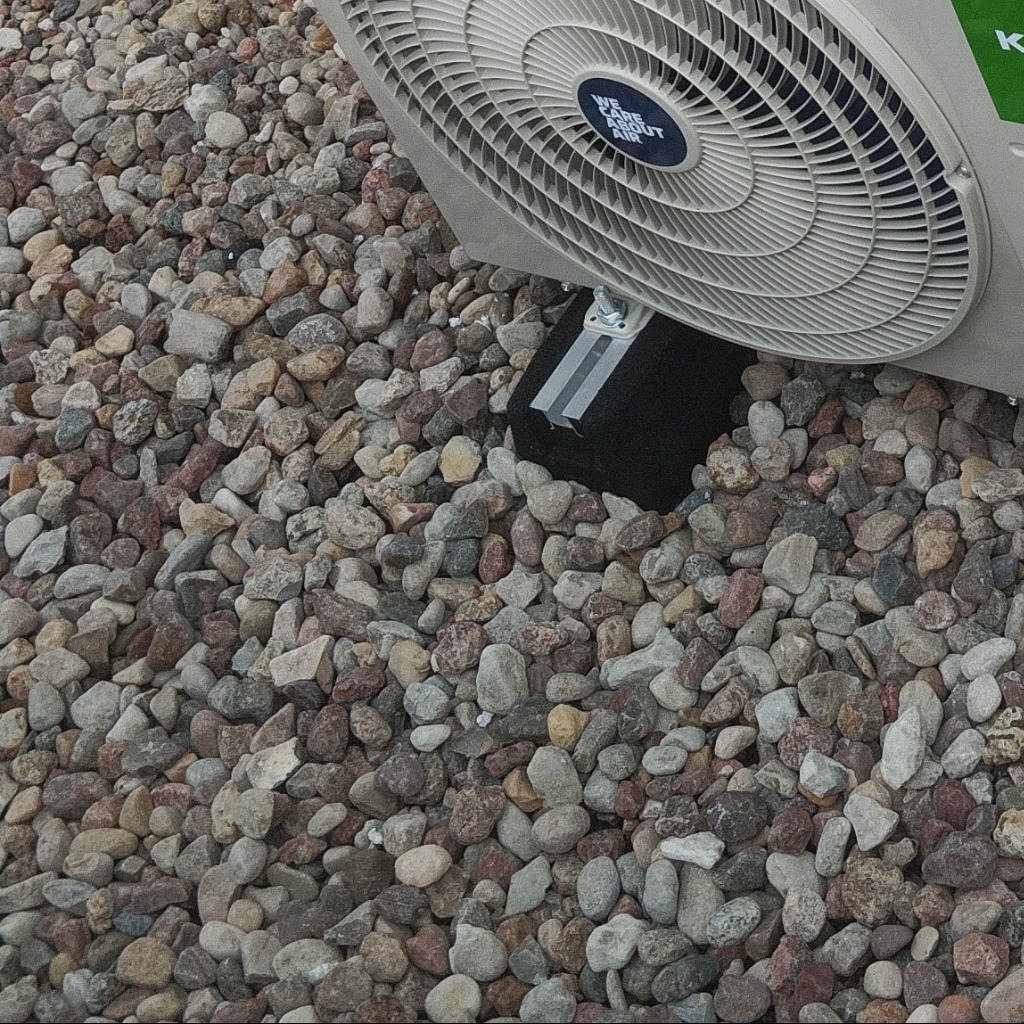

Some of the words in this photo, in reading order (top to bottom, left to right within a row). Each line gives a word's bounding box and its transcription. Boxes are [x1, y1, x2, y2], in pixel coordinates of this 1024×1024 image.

[591, 94, 622, 110] WE
[599, 107, 645, 125] CARE
[607, 117, 664, 139] ABOUT
[613, 128, 643, 144] AIR
